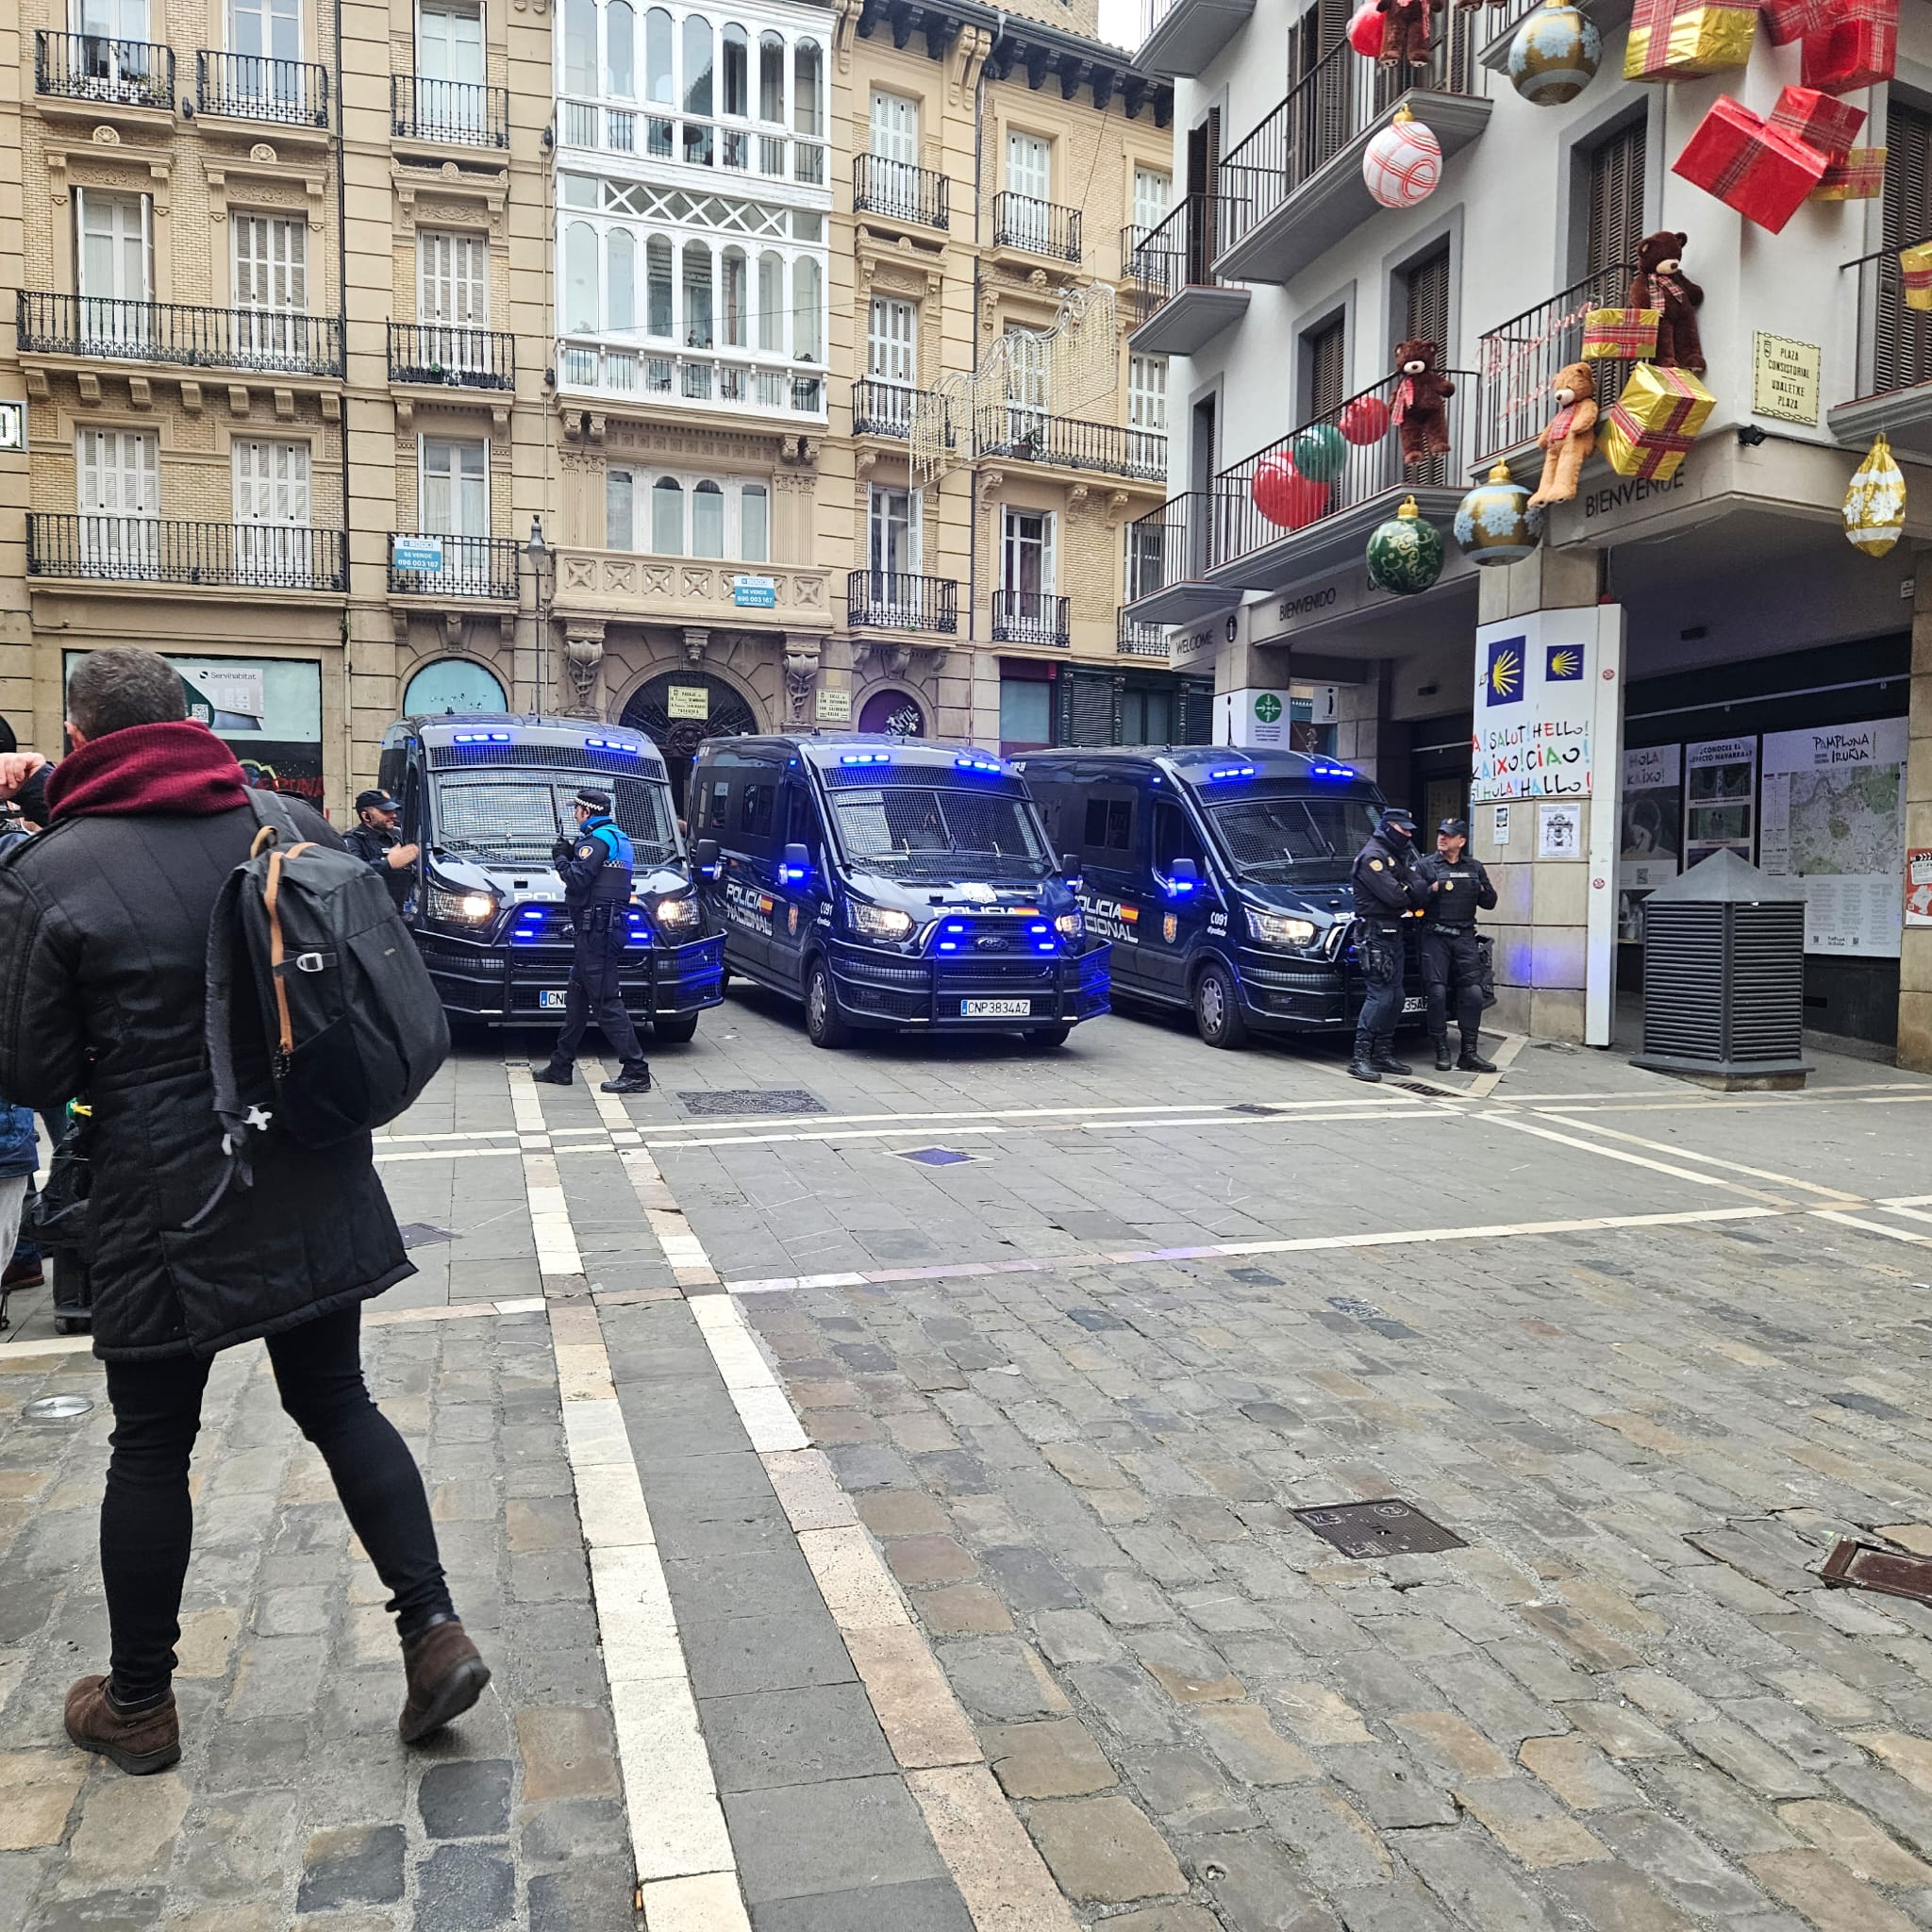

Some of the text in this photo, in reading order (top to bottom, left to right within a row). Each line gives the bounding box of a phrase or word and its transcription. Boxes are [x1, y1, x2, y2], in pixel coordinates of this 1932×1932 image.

[1780, 347, 1799, 360] PLAZA
[1768, 359, 1809, 378] CONSISTORIAL
[1772, 379, 1805, 397] UDALETXE
[1777, 395, 1798, 409] PLAZA
[1279, 587, 1337, 622] BIENVENIDO
[1176, 630, 1213, 656] WELCOME
[211, 671, 257, 680] Servihabitat
[1812, 733, 1870, 750] PAMPLONA
[1832, 748, 1870, 763] IRUÑA
[726, 883, 762, 911] POLICIA
[933, 907, 1016, 918] POLICIA
[1074, 895, 1122, 921] OLICIA
[727, 905, 772, 937] NACIONAL
[1084, 915, 1139, 943] CIONAL
[968, 1002, 1028, 1014] CNP3834AZ
